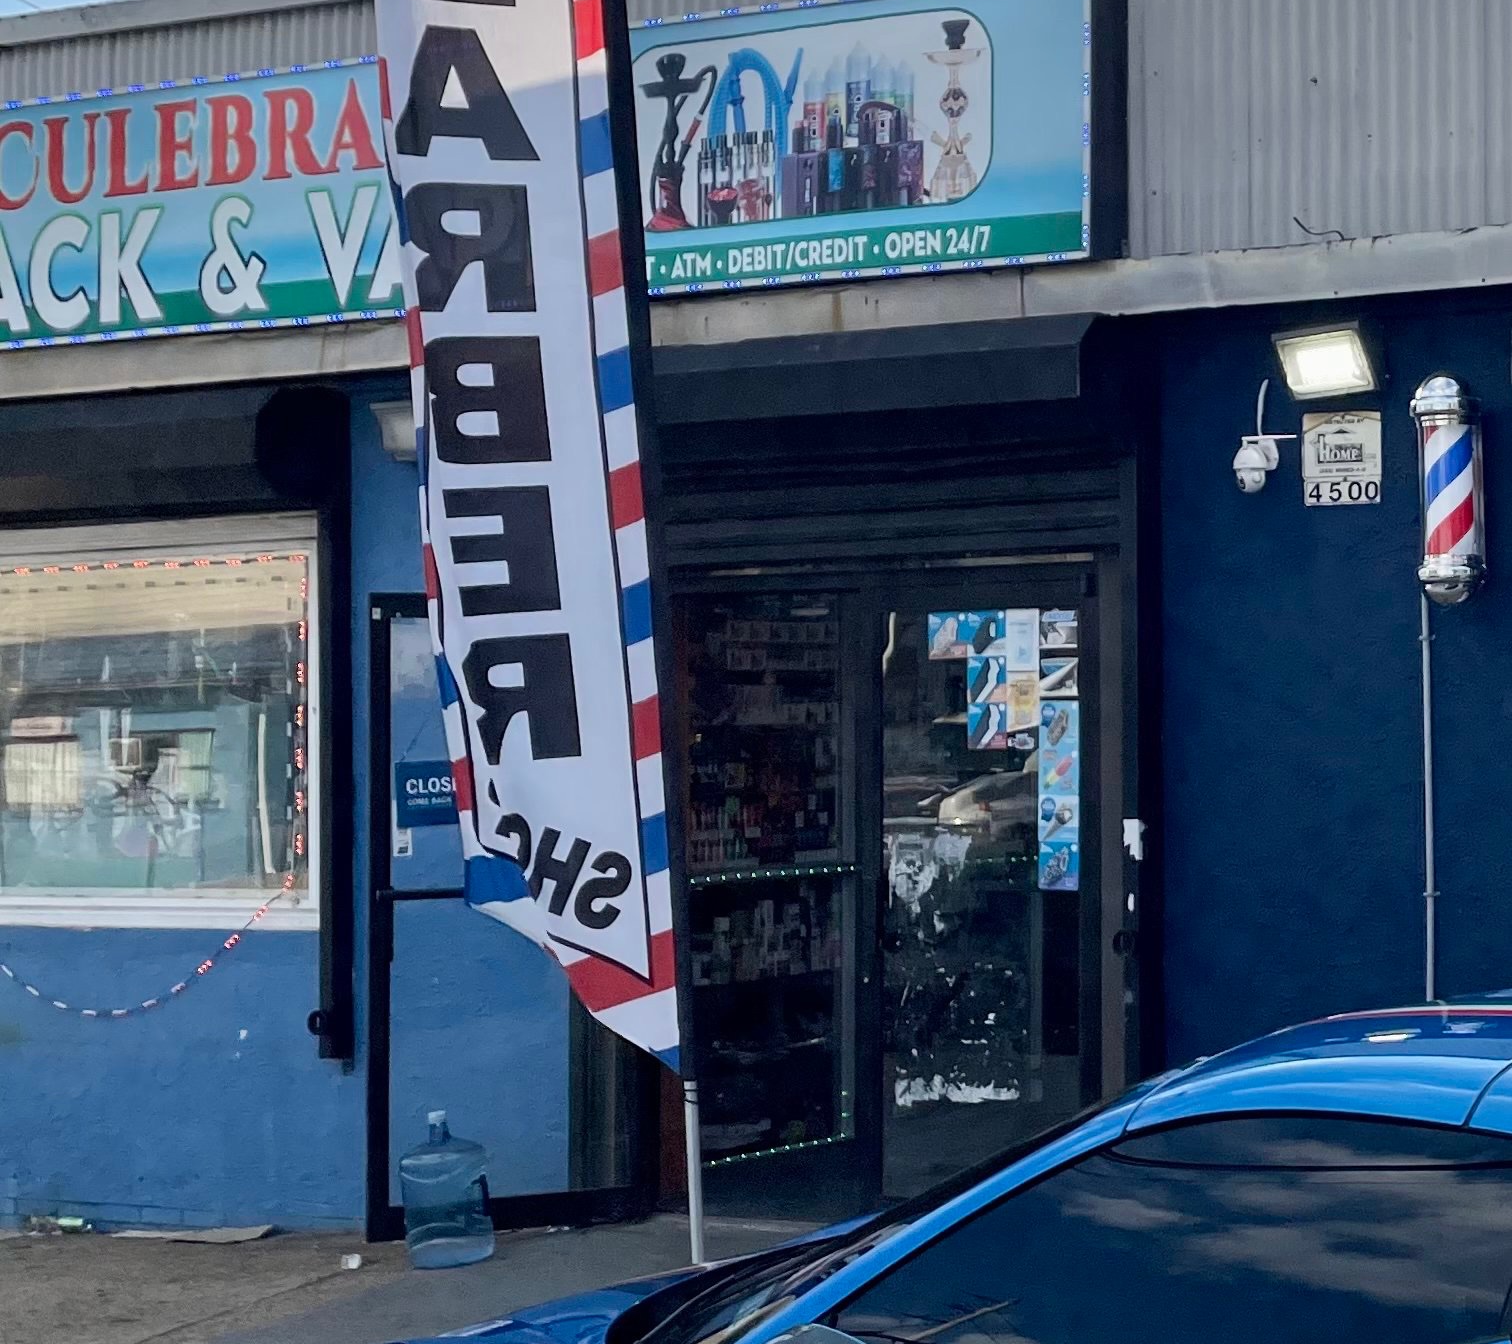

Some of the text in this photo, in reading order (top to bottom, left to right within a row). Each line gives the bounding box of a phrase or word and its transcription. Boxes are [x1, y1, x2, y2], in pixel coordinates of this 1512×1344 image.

[0, 77, 385, 211] CULEBRA
[200, 193, 268, 316] &
[671, 250, 711, 279] ATM
[728, 235, 868, 276] DEBIT/CREDIT
[884, 229, 943, 258] OPEN
[946, 225, 992, 256] 24/7
[1308, 481, 1379, 503] 4500
